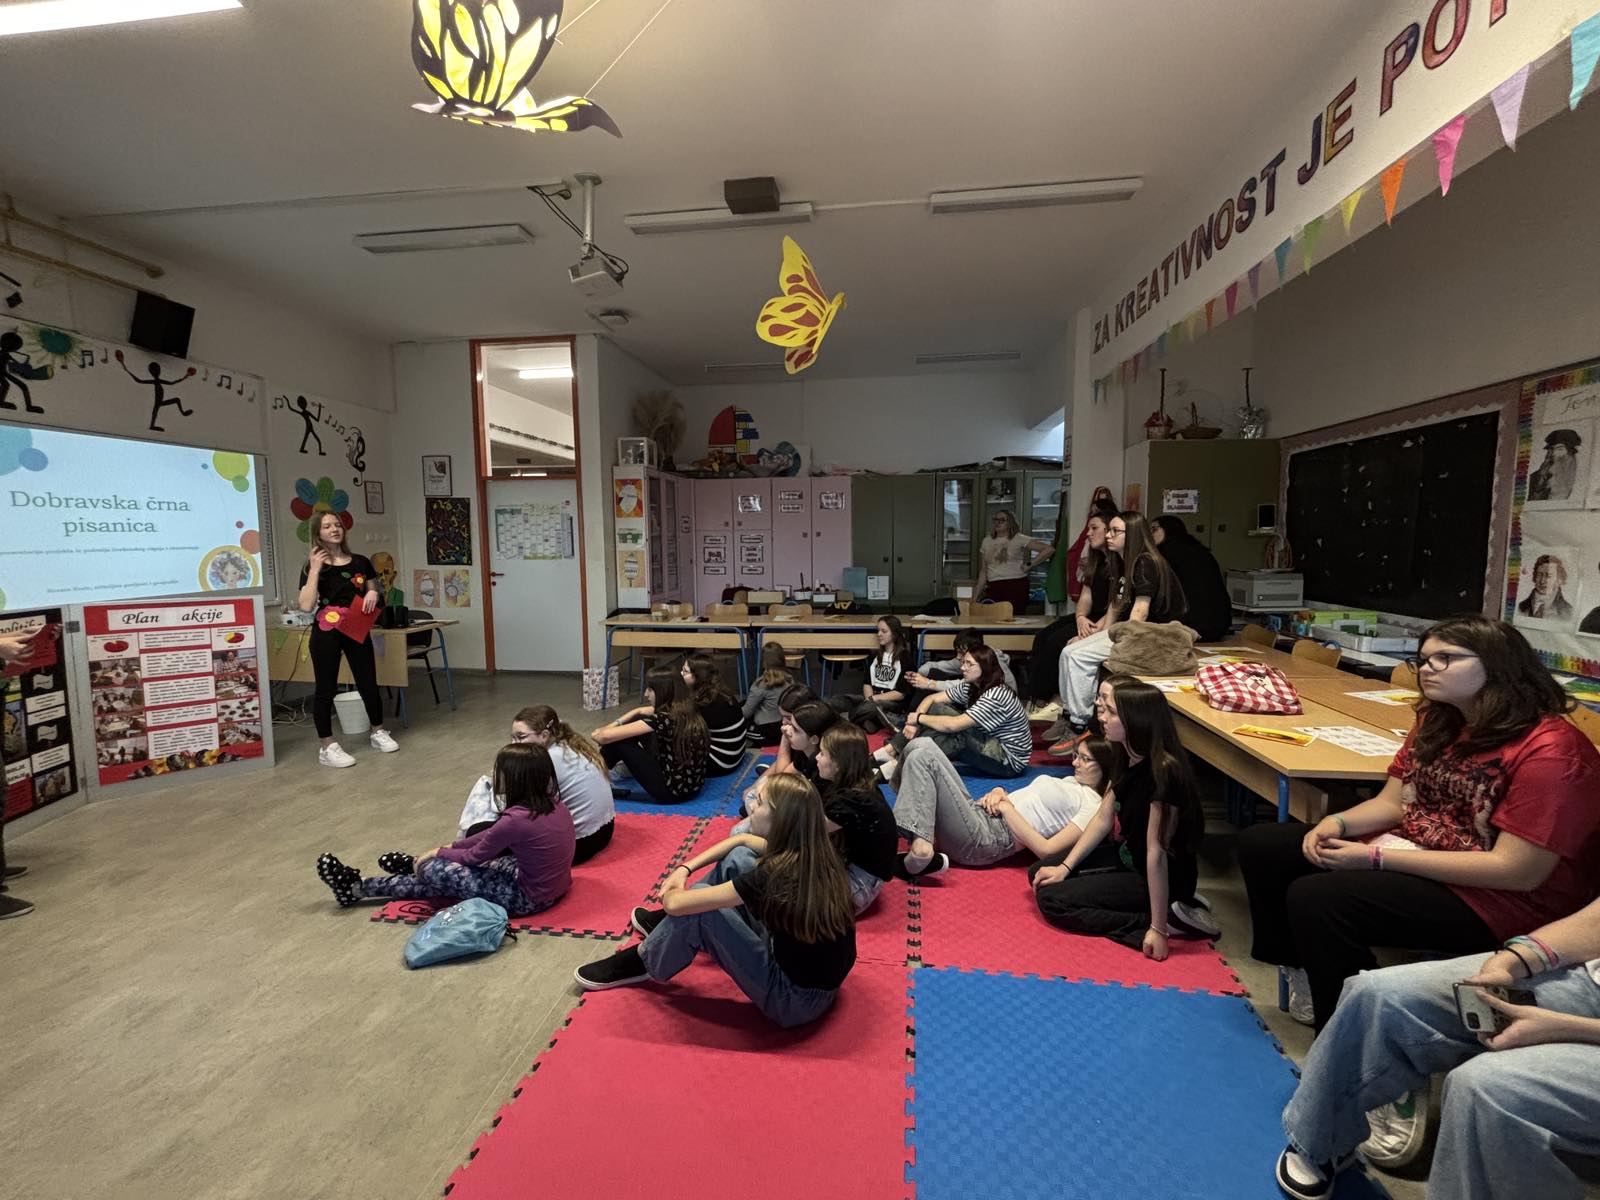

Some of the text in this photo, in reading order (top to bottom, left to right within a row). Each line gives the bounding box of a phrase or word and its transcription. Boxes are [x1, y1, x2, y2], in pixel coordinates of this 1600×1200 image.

[1093, 313, 1111, 354] ZA
[1114, 147, 1287, 337] KREATIVNOST
[1296, 77, 1357, 187] JE
[9, 490, 191, 512] Dobravska črna
[62, 517, 157, 537] pisanica
[122, 608, 223, 625] Plan akcije
